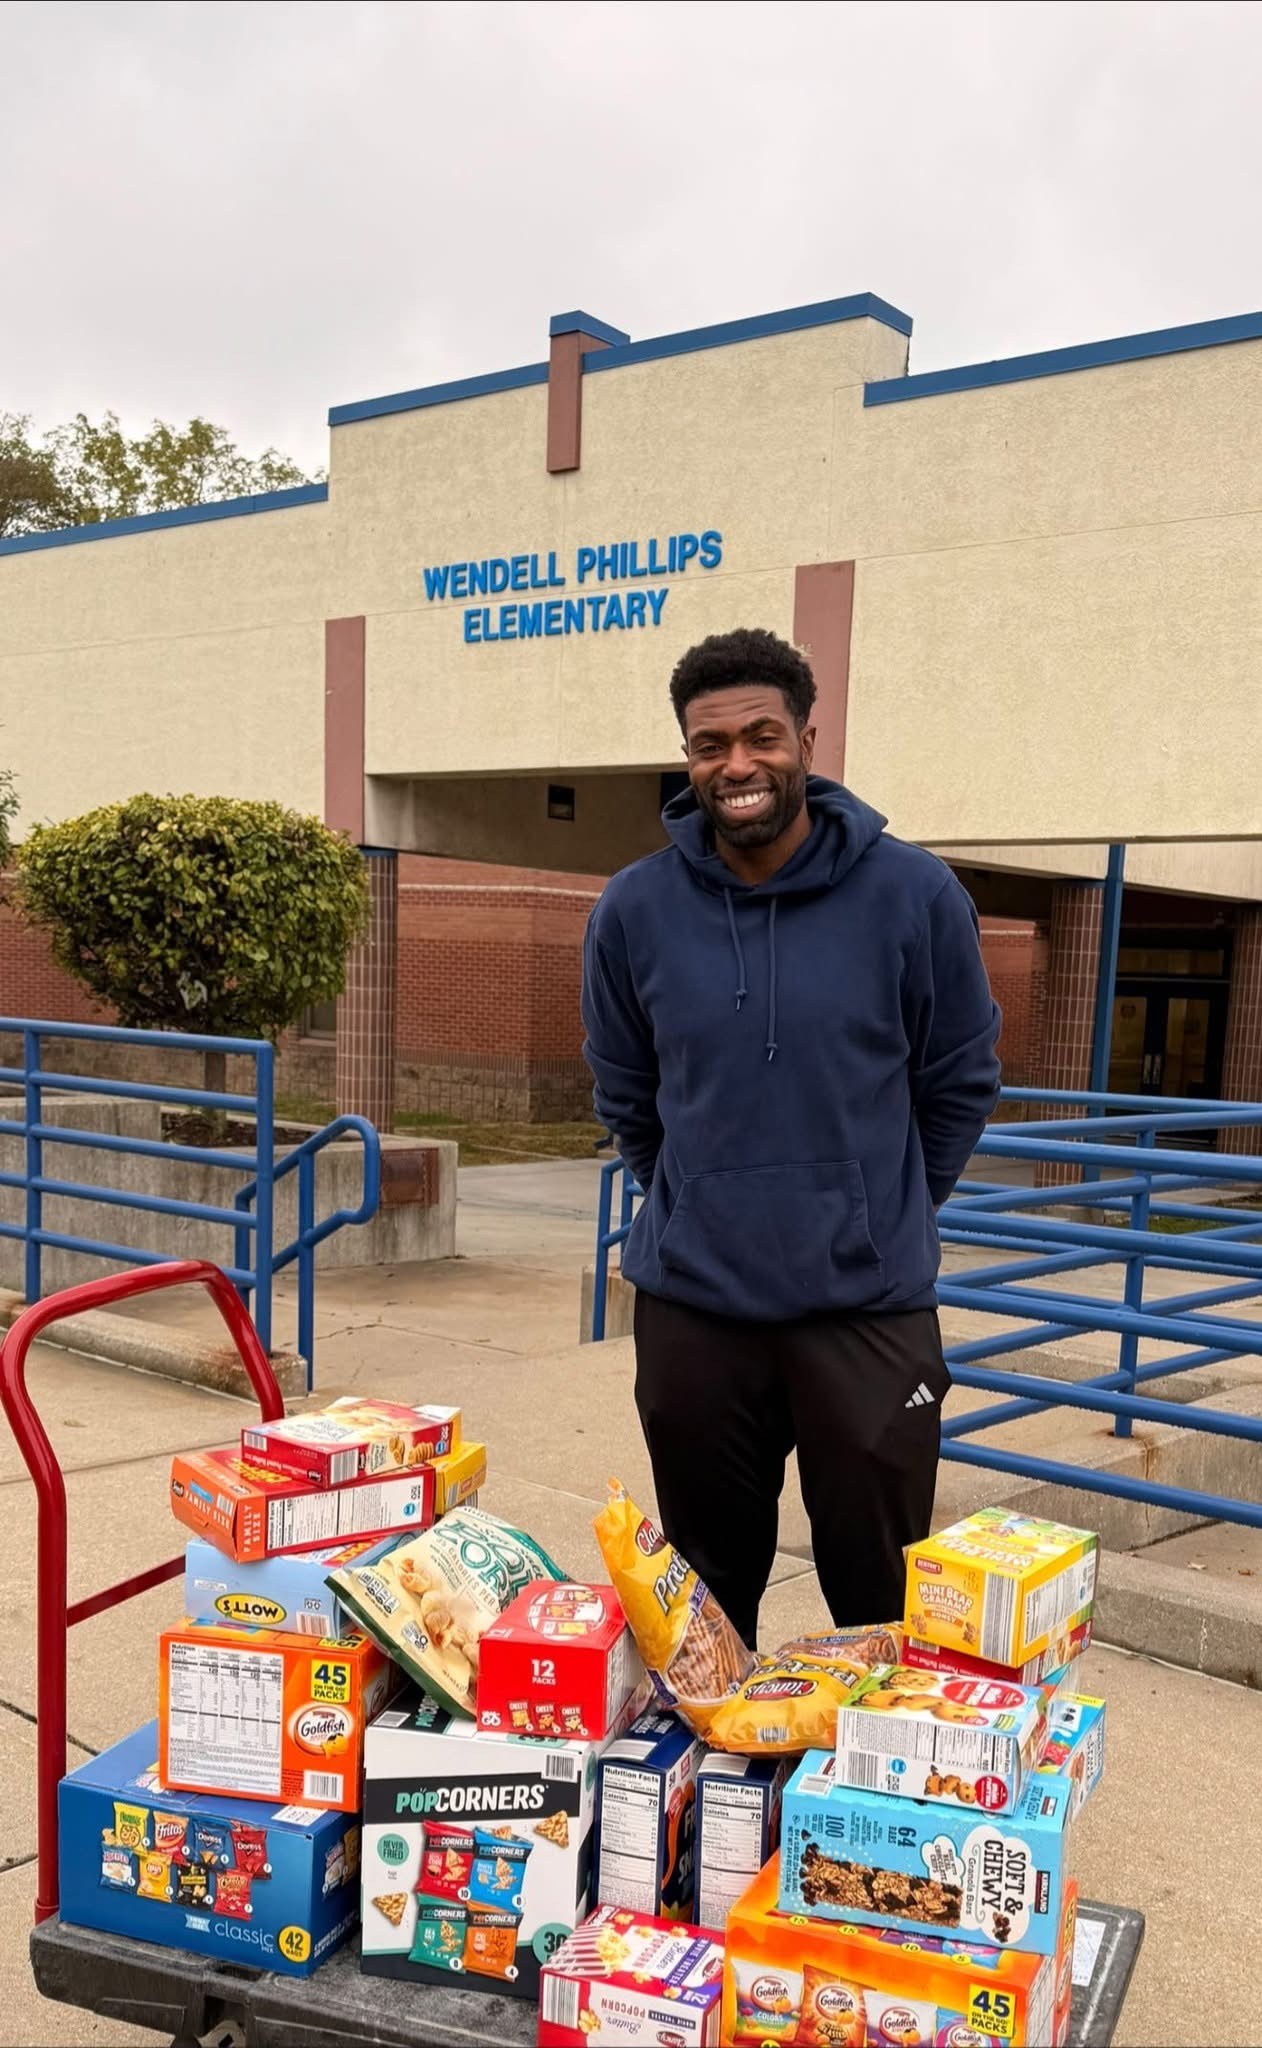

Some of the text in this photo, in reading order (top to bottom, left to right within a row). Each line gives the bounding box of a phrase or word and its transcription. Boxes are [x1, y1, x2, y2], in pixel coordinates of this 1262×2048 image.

[423, 530, 722, 601] WENDELL PHILLIPS
[464, 588, 669, 643] ELEMENTARY
[184, 1489, 231, 1529] FAMILY SIZE
[243, 1504, 252, 1553] FAMILY
[253, 1512, 261, 1543] SIZE
[919, 1583, 973, 1608] MINI BEAR
[921, 1594, 969, 1616] GRAHAMS
[171, 1649, 187, 1657] Facts
[313, 1663, 348, 1687] 45
[531, 1659, 555, 1677] 12
[532, 1677, 556, 1685] PACKS
[746, 1677, 818, 1700] Clancy's
[314, 1689, 345, 1701] PACKS
[301, 1719, 345, 1738] Goldfish
[605, 1767, 659, 1783] Nutrition Facts
[396, 1784, 545, 1814] POPCORNERS
[604, 1791, 628, 1801] Calories
[704, 1783, 762, 1797] Nutrition Facts
[648, 1799, 658, 1807] 70
[704, 1808, 729, 1817] Calories
[750, 1812, 761, 1820] 70
[825, 1814, 845, 1838] 100
[156, 1823, 183, 1838] Fritos
[887, 1825, 897, 1844] BARS
[898, 1826, 917, 1848] 64
[383, 1839, 404, 1850] NEVER
[383, 1848, 404, 1860] FRIED
[981, 1840, 1003, 1911] CHEWY
[1004, 1849, 1026, 1915] SOFT &
[460, 1889, 469, 1898] 10
[966, 1858, 976, 1916] Granola Bars
[1040, 1872, 1049, 1913] KIRKLAND
[214, 1920, 274, 1948] classic
[285, 1931, 304, 1951] 42
[544, 1932, 567, 1952] 30
[756, 1985, 789, 1997] Goldfish
[601, 1998, 646, 2019] POPCORN
[821, 1994, 853, 2009] Goldfish
[972, 1990, 1011, 2018] 45
[605, 2016, 642, 2036] Butter
[884, 2016, 919, 2029] Goldfish
[972, 2018, 1008, 2034] PACKS
[954, 2032, 983, 2045] Goldfish
